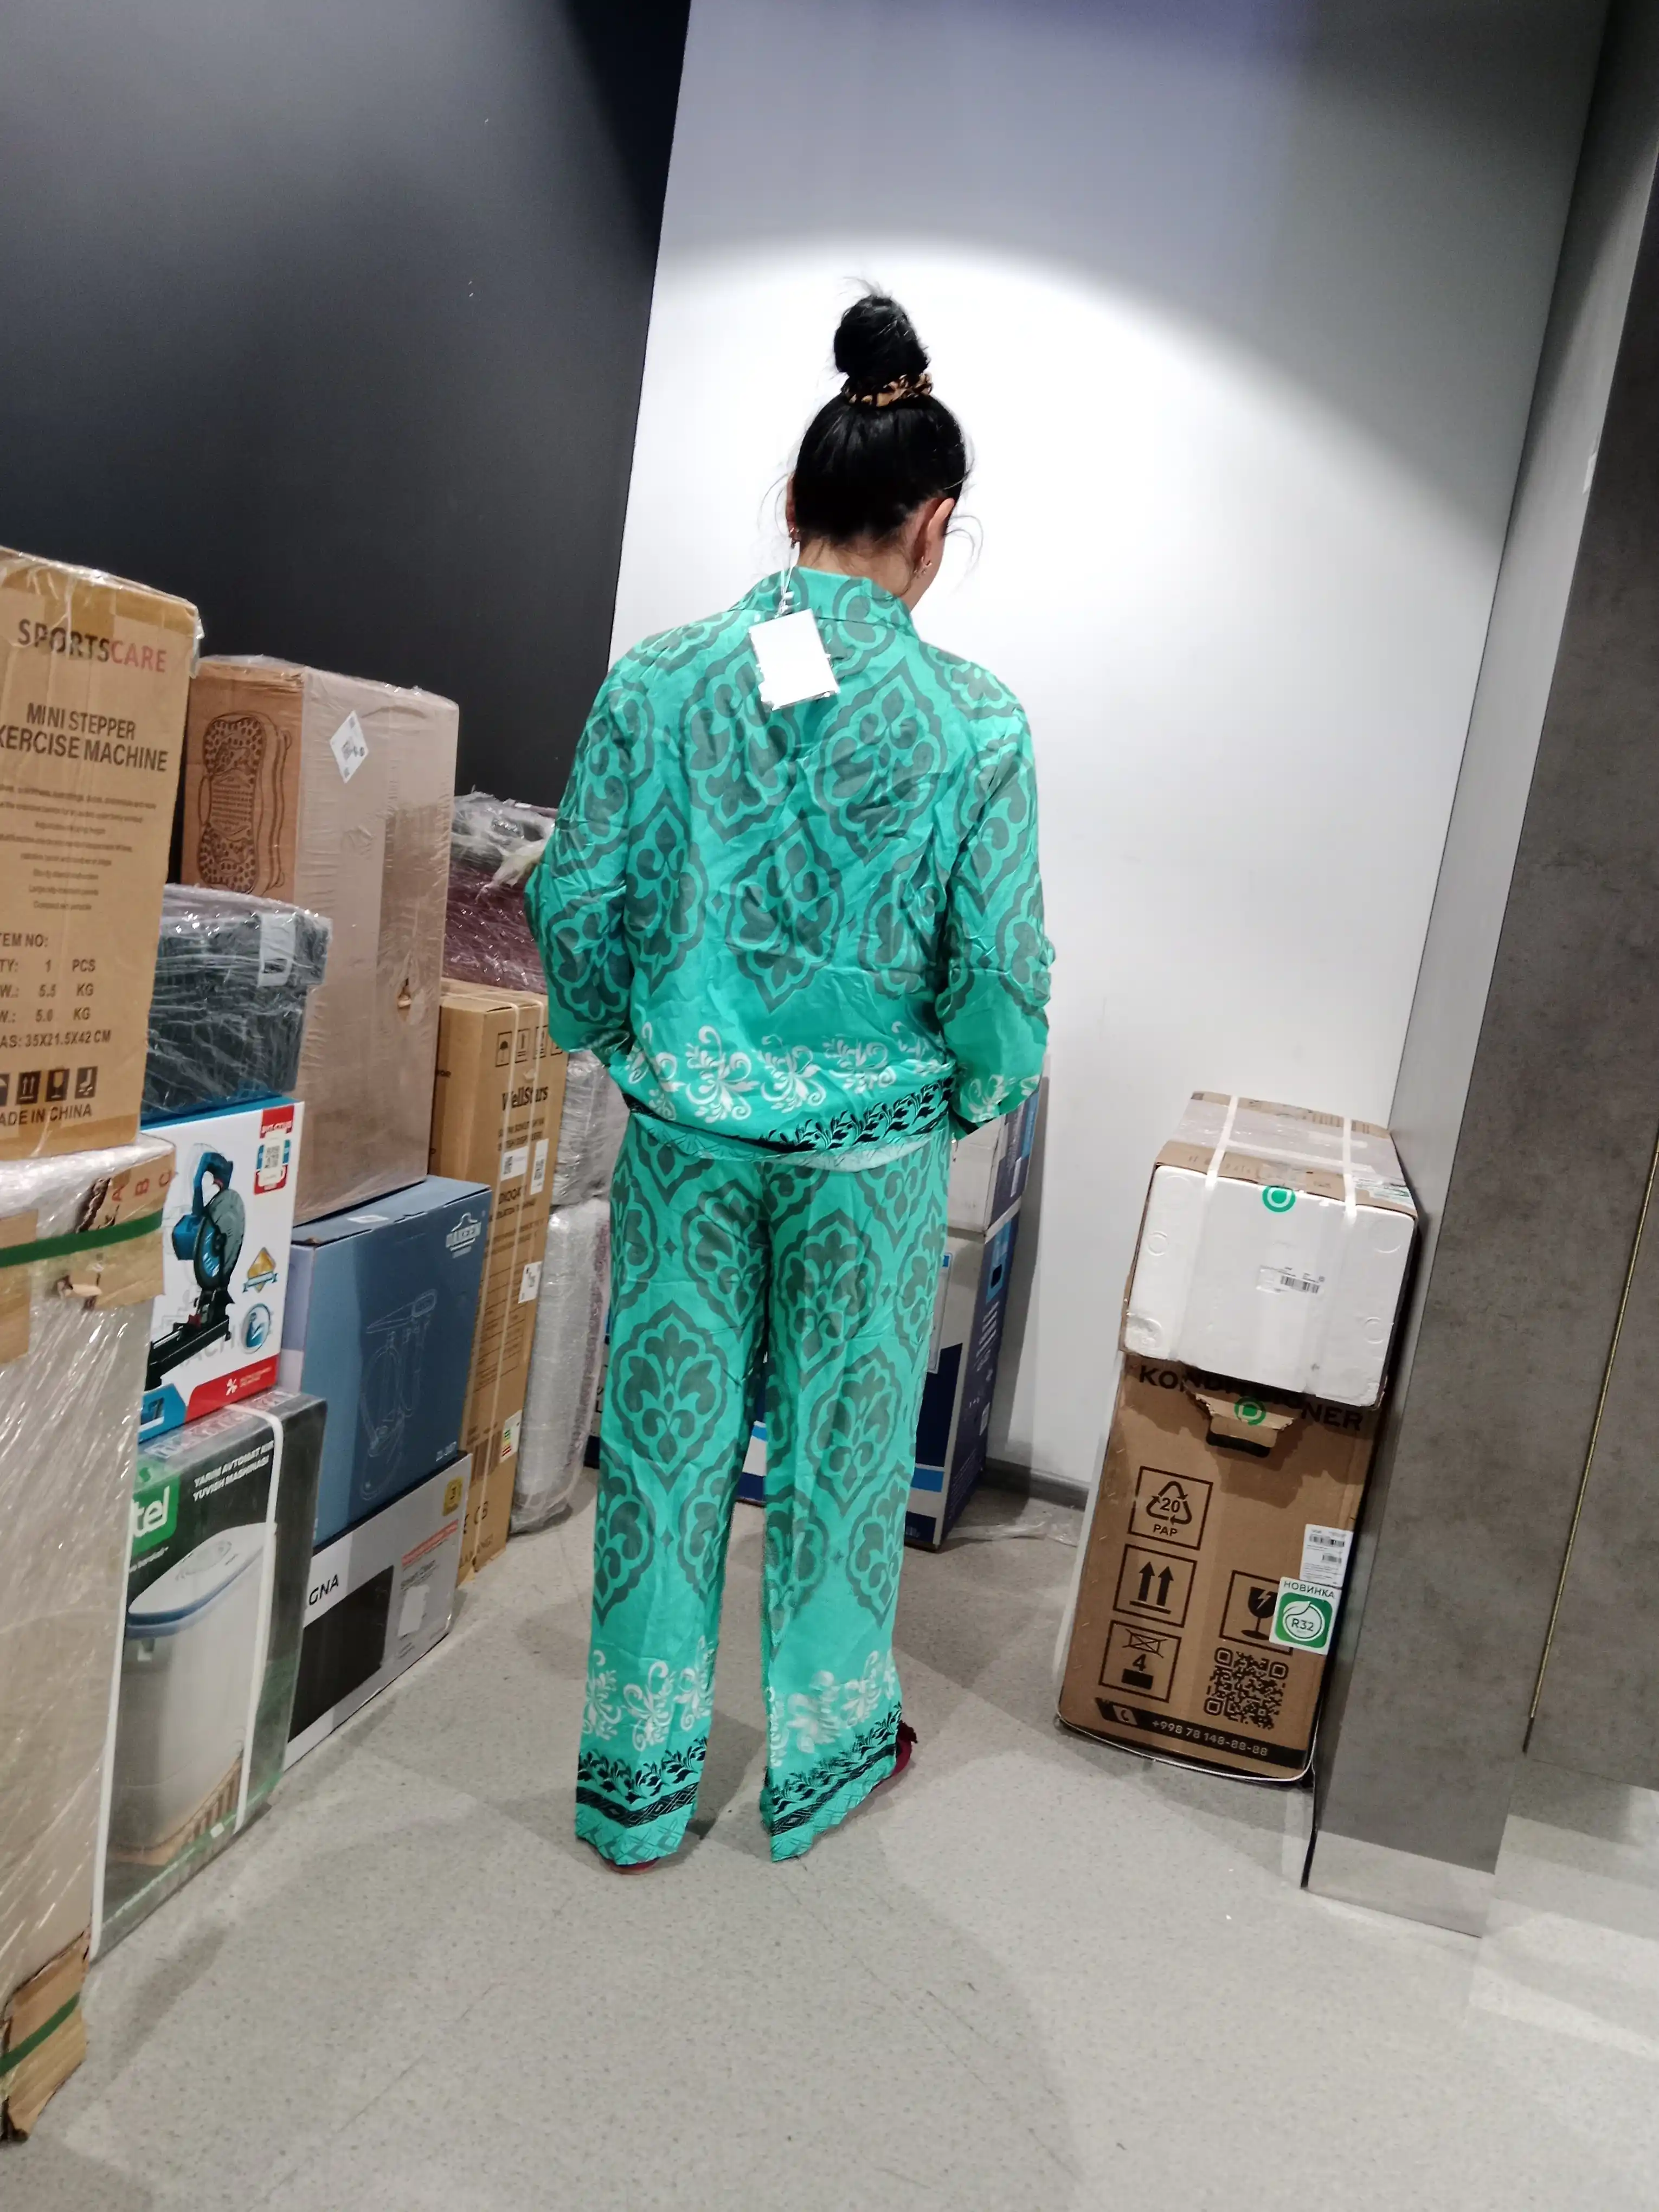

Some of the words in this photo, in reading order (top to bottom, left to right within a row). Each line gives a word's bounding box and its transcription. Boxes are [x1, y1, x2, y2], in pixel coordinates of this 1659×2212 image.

[17, 619, 166, 672] SPORTSCARE
[27, 703, 65, 729] MINI
[69, 712, 136, 741] STEPPER
[83, 739, 168, 771] MACHINE
[25, 933, 48, 947] NO:
[45, 959, 52, 973] 1
[72, 959, 95, 972] PCS
[76, 982, 94, 996] KG
[73, 1007, 90, 1020] KG
[94, 1029, 111, 1044] CM
[31, 1108, 46, 1124] IN
[50, 1103, 92, 1122] CHINA
[1160, 1497, 1181, 1513] 20
[1153, 1524, 1178, 1537] PAP
[1284, 1581, 1335, 1599] НОВИНКА
[1291, 1618, 1314, 1631] R32
[1133, 1653, 1147, 1672] 4
[1152, 1719, 1183, 1734] +998
[1186, 1727, 1200, 1739] 78
[1203, 1732, 1269, 1757] 148-88-88
